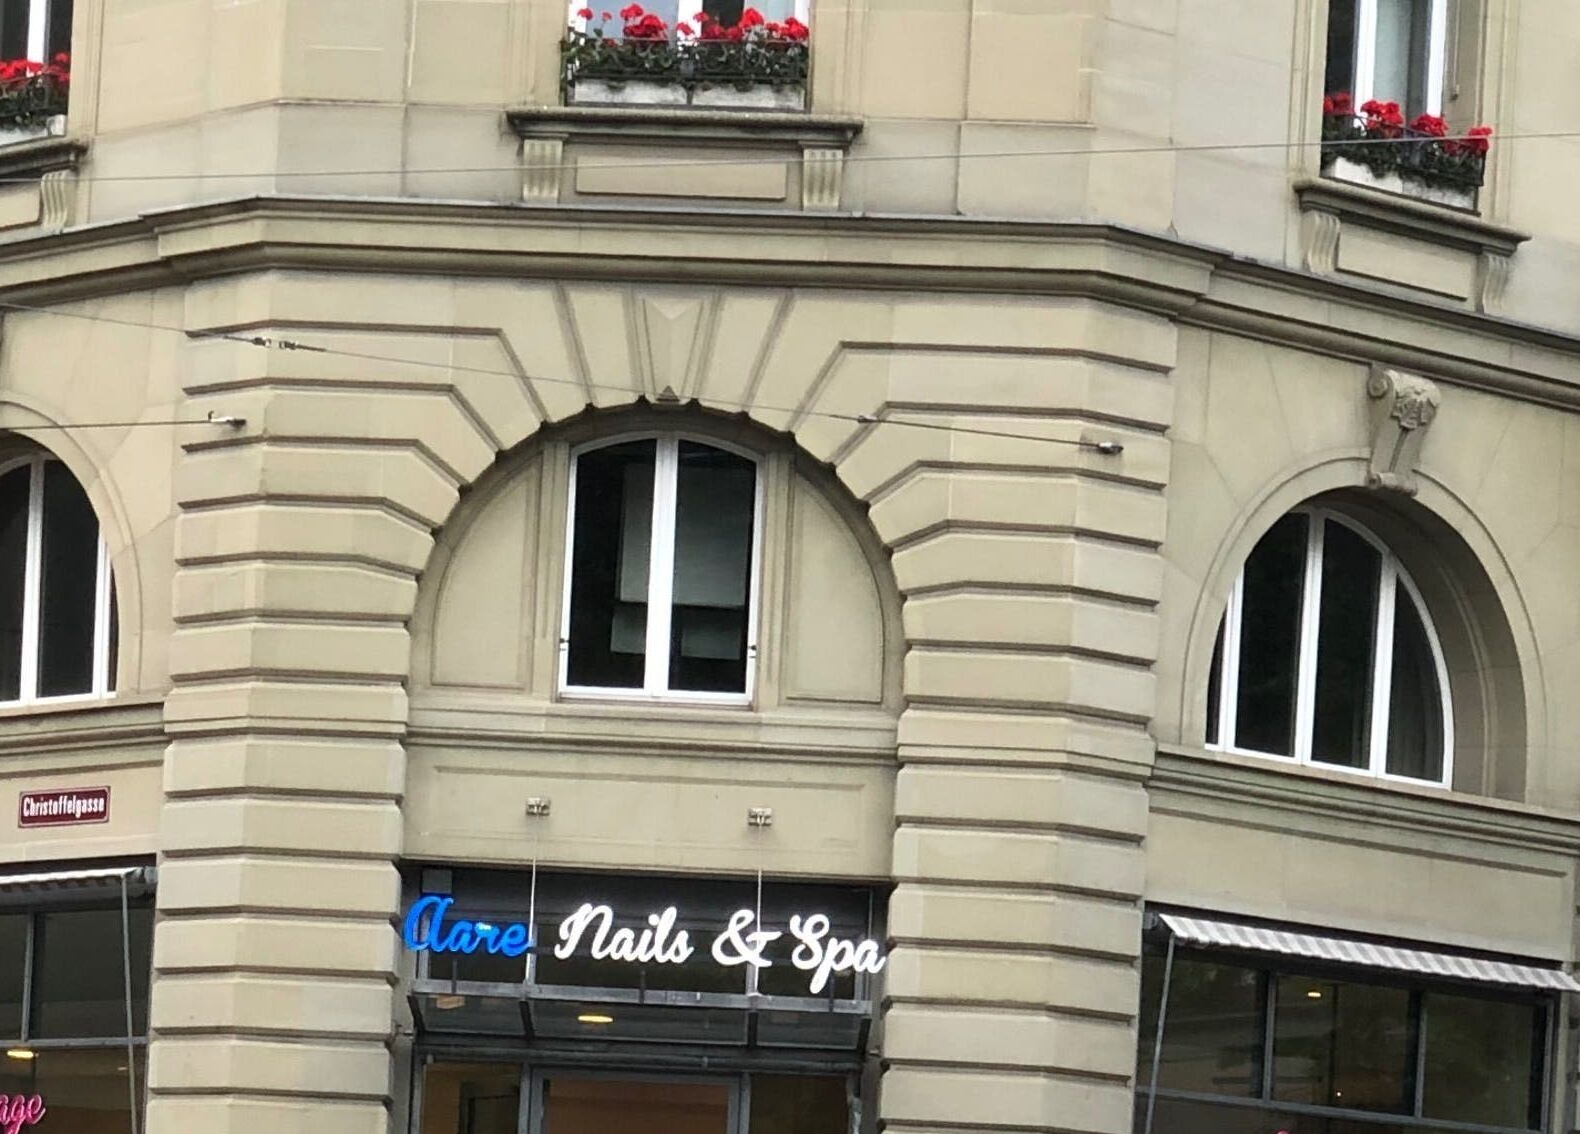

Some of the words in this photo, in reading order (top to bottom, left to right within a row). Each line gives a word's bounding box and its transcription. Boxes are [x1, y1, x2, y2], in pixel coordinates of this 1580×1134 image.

[23, 795, 105, 818] Christoffelgasse
[404, 896, 533, 957] Aare
[554, 903, 694, 963] Nails
[712, 909, 782, 966] &
[790, 914, 886, 994] Spa
